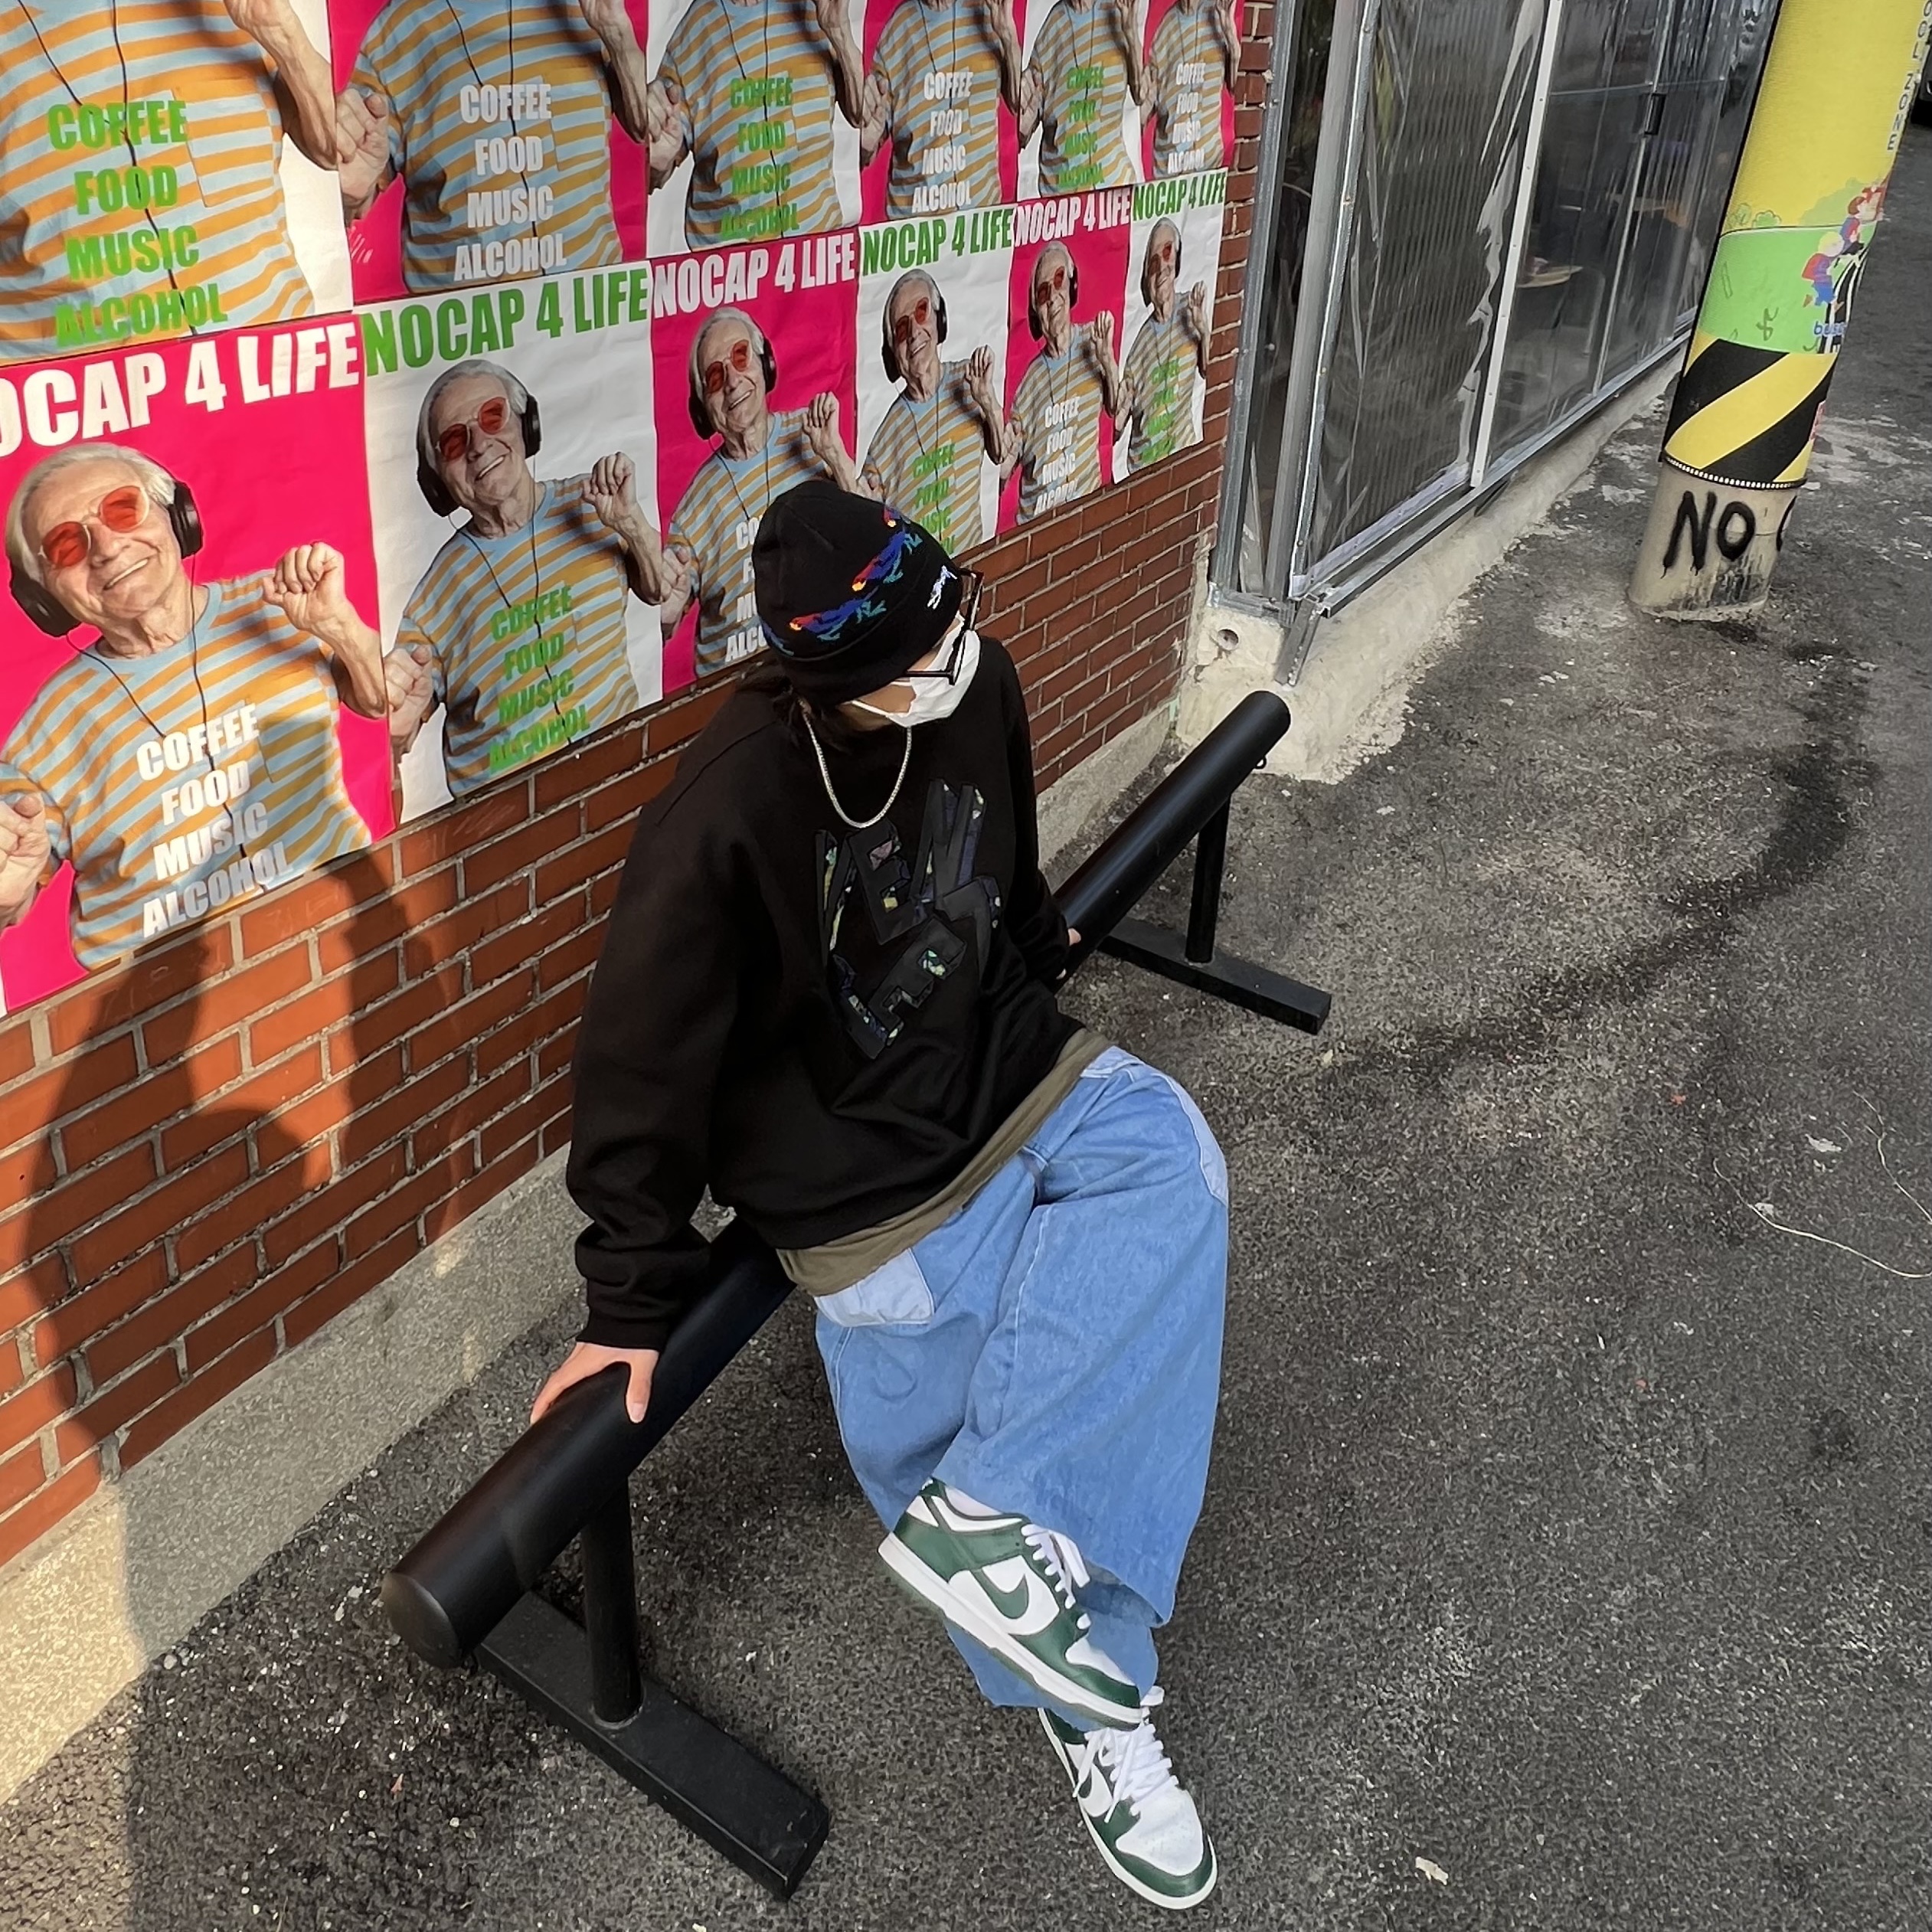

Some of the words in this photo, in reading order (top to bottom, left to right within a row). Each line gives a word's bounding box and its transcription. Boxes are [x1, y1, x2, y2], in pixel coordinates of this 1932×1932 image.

[460, 83, 551, 124] COFFEE
[924, 72, 973, 100] COFFEE
[1887, 73, 1914, 150] ZONE
[47, 100, 188, 150] COFFEE
[738, 121, 785, 152] FOOD
[930, 110, 963, 137] FOOD
[475, 136, 543, 176] FOOD
[732, 162, 790, 195] MUSIC
[922, 145, 966, 175] MUSIC
[74, 165, 178, 215] FOOD
[467, 185, 554, 228] MUSIC
[912, 181, 971, 213] ALCOHOL
[1133, 180, 1187, 221] NOCAP
[1188, 176, 1198, 209] 4
[1198, 172, 1226, 207] LIFE
[863, 219, 946, 276] NOCAP
[952, 215, 965, 257] 4
[970, 208, 1014, 253] LIFE
[1015, 197, 1080, 247] NOCAP
[1084, 194, 1096, 231] 4
[1099, 187, 1129, 229] LIFE
[64, 224, 199, 282] MUSIC
[454, 234, 567, 282] ALCOHOL
[654, 249, 769, 319] NOCAP
[775, 244, 795, 293] 4
[801, 233, 855, 289] LIFE
[54, 283, 228, 349] ALCOHOL
[361, 289, 525, 377] NOCAP
[537, 281, 564, 338] 4
[574, 268, 648, 333] LIFE
[185, 341, 227, 413] 4
[237, 322, 359, 404] LIFE
[1042, 453, 1075, 485] MUSIC
[1661, 491, 1756, 576] NO
[490, 586, 572, 642] COFFEE
[504, 633, 564, 681] FOOD
[499, 669, 574, 724] MUSIC
[137, 704, 259, 781] COFFEE
[162, 760, 250, 825] FOOD
[153, 803, 268, 880] MUSIC
[143, 842, 293, 938] ALCOHOL
